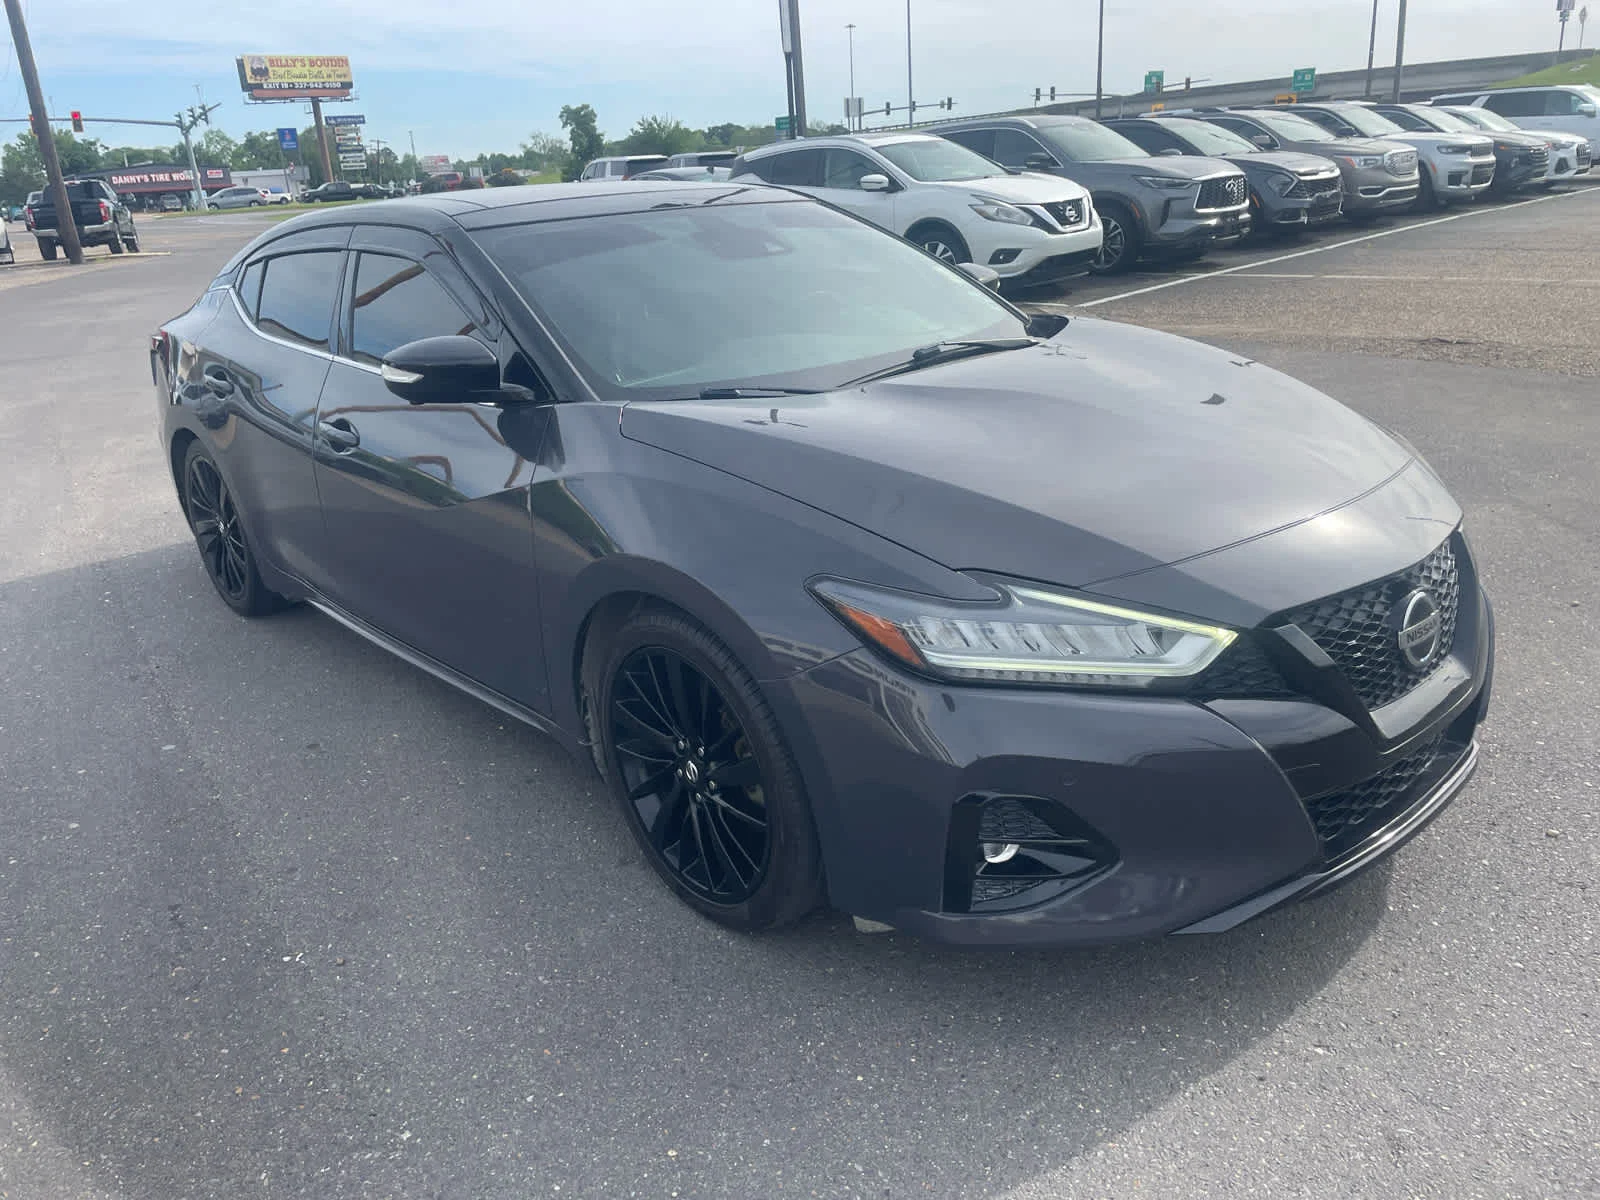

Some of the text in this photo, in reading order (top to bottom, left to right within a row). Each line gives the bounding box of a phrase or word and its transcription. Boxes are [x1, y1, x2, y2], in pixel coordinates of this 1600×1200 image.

[268, 58, 348, 68] BILLY'S BOUDIN
[112, 175, 149, 185] DANNY'S
[150, 173, 171, 182] TIRE
